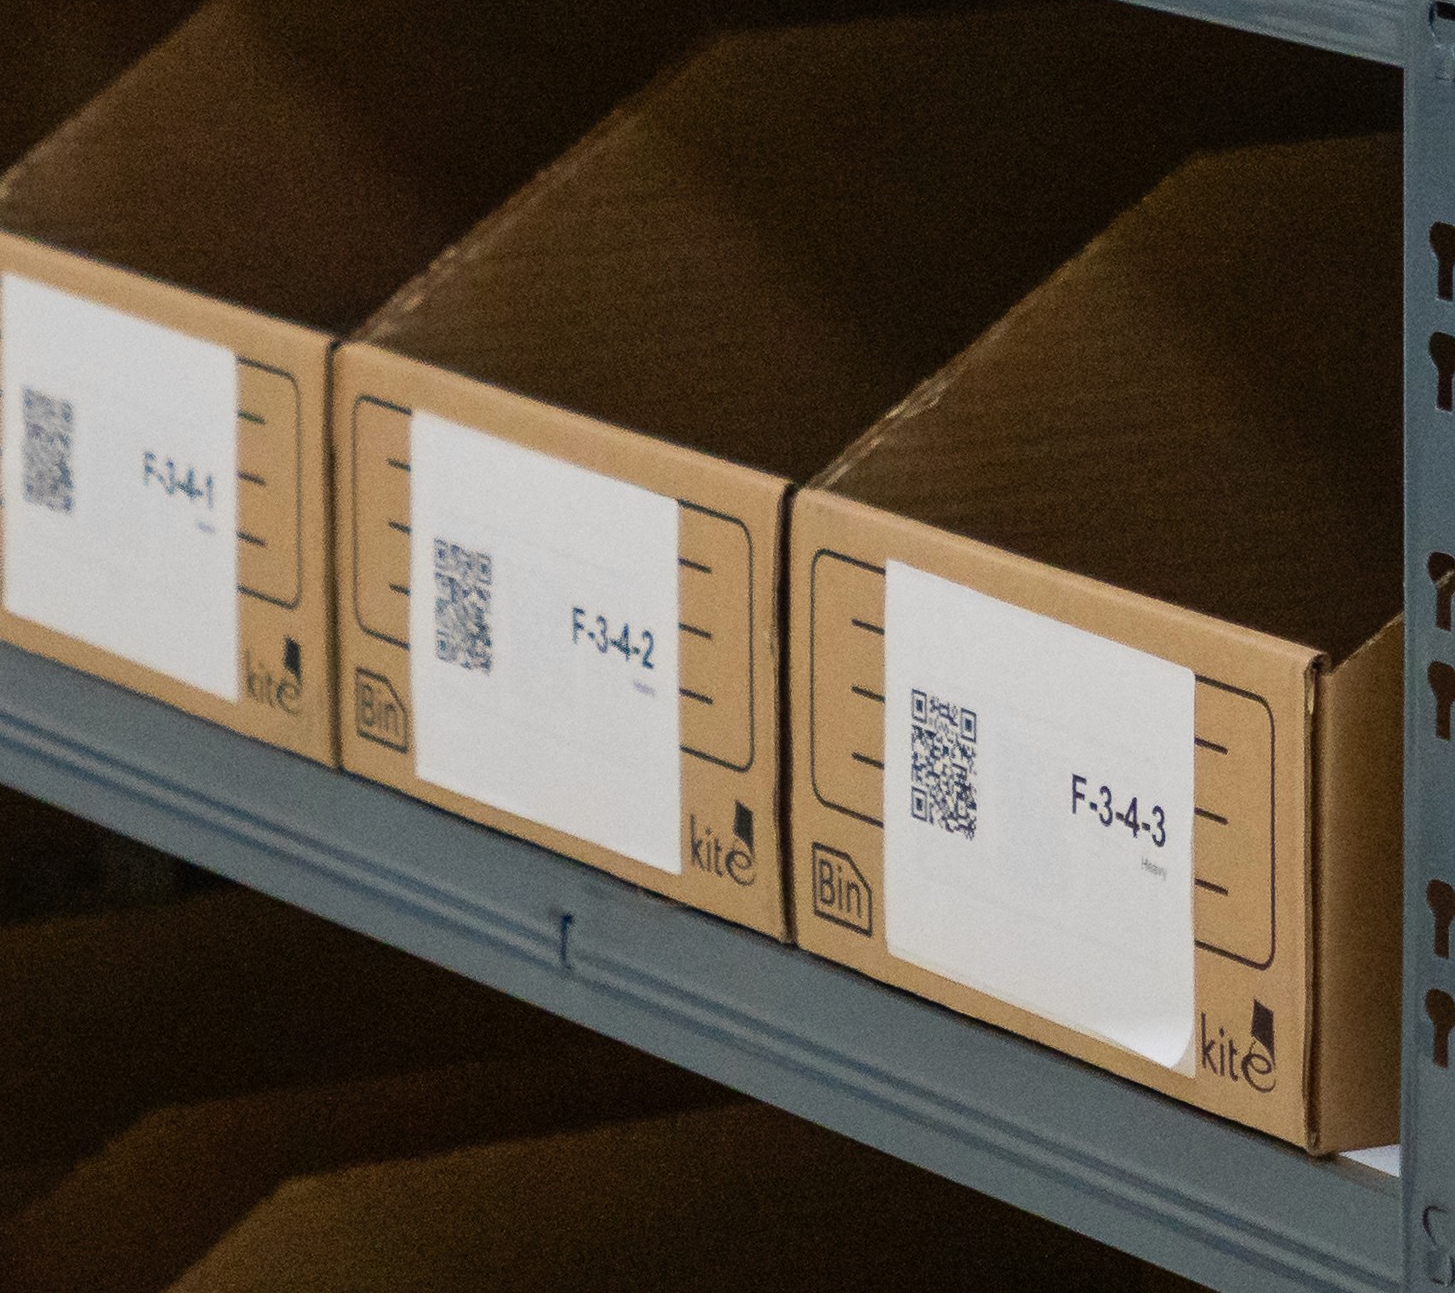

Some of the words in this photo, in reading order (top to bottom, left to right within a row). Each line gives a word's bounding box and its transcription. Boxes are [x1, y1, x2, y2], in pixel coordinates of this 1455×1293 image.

[143, 452, 216, 508] F-3-4-1
[571, 606, 655, 670] F-3-4-2
[244, 656, 303, 713] kite
[361, 682, 403, 741] Bin
[1071, 774, 1167, 849] F-3-4-3
[690, 812, 756, 886] kite
[819, 854, 865, 919] Bin
[1201, 1013, 1277, 1093] kite
